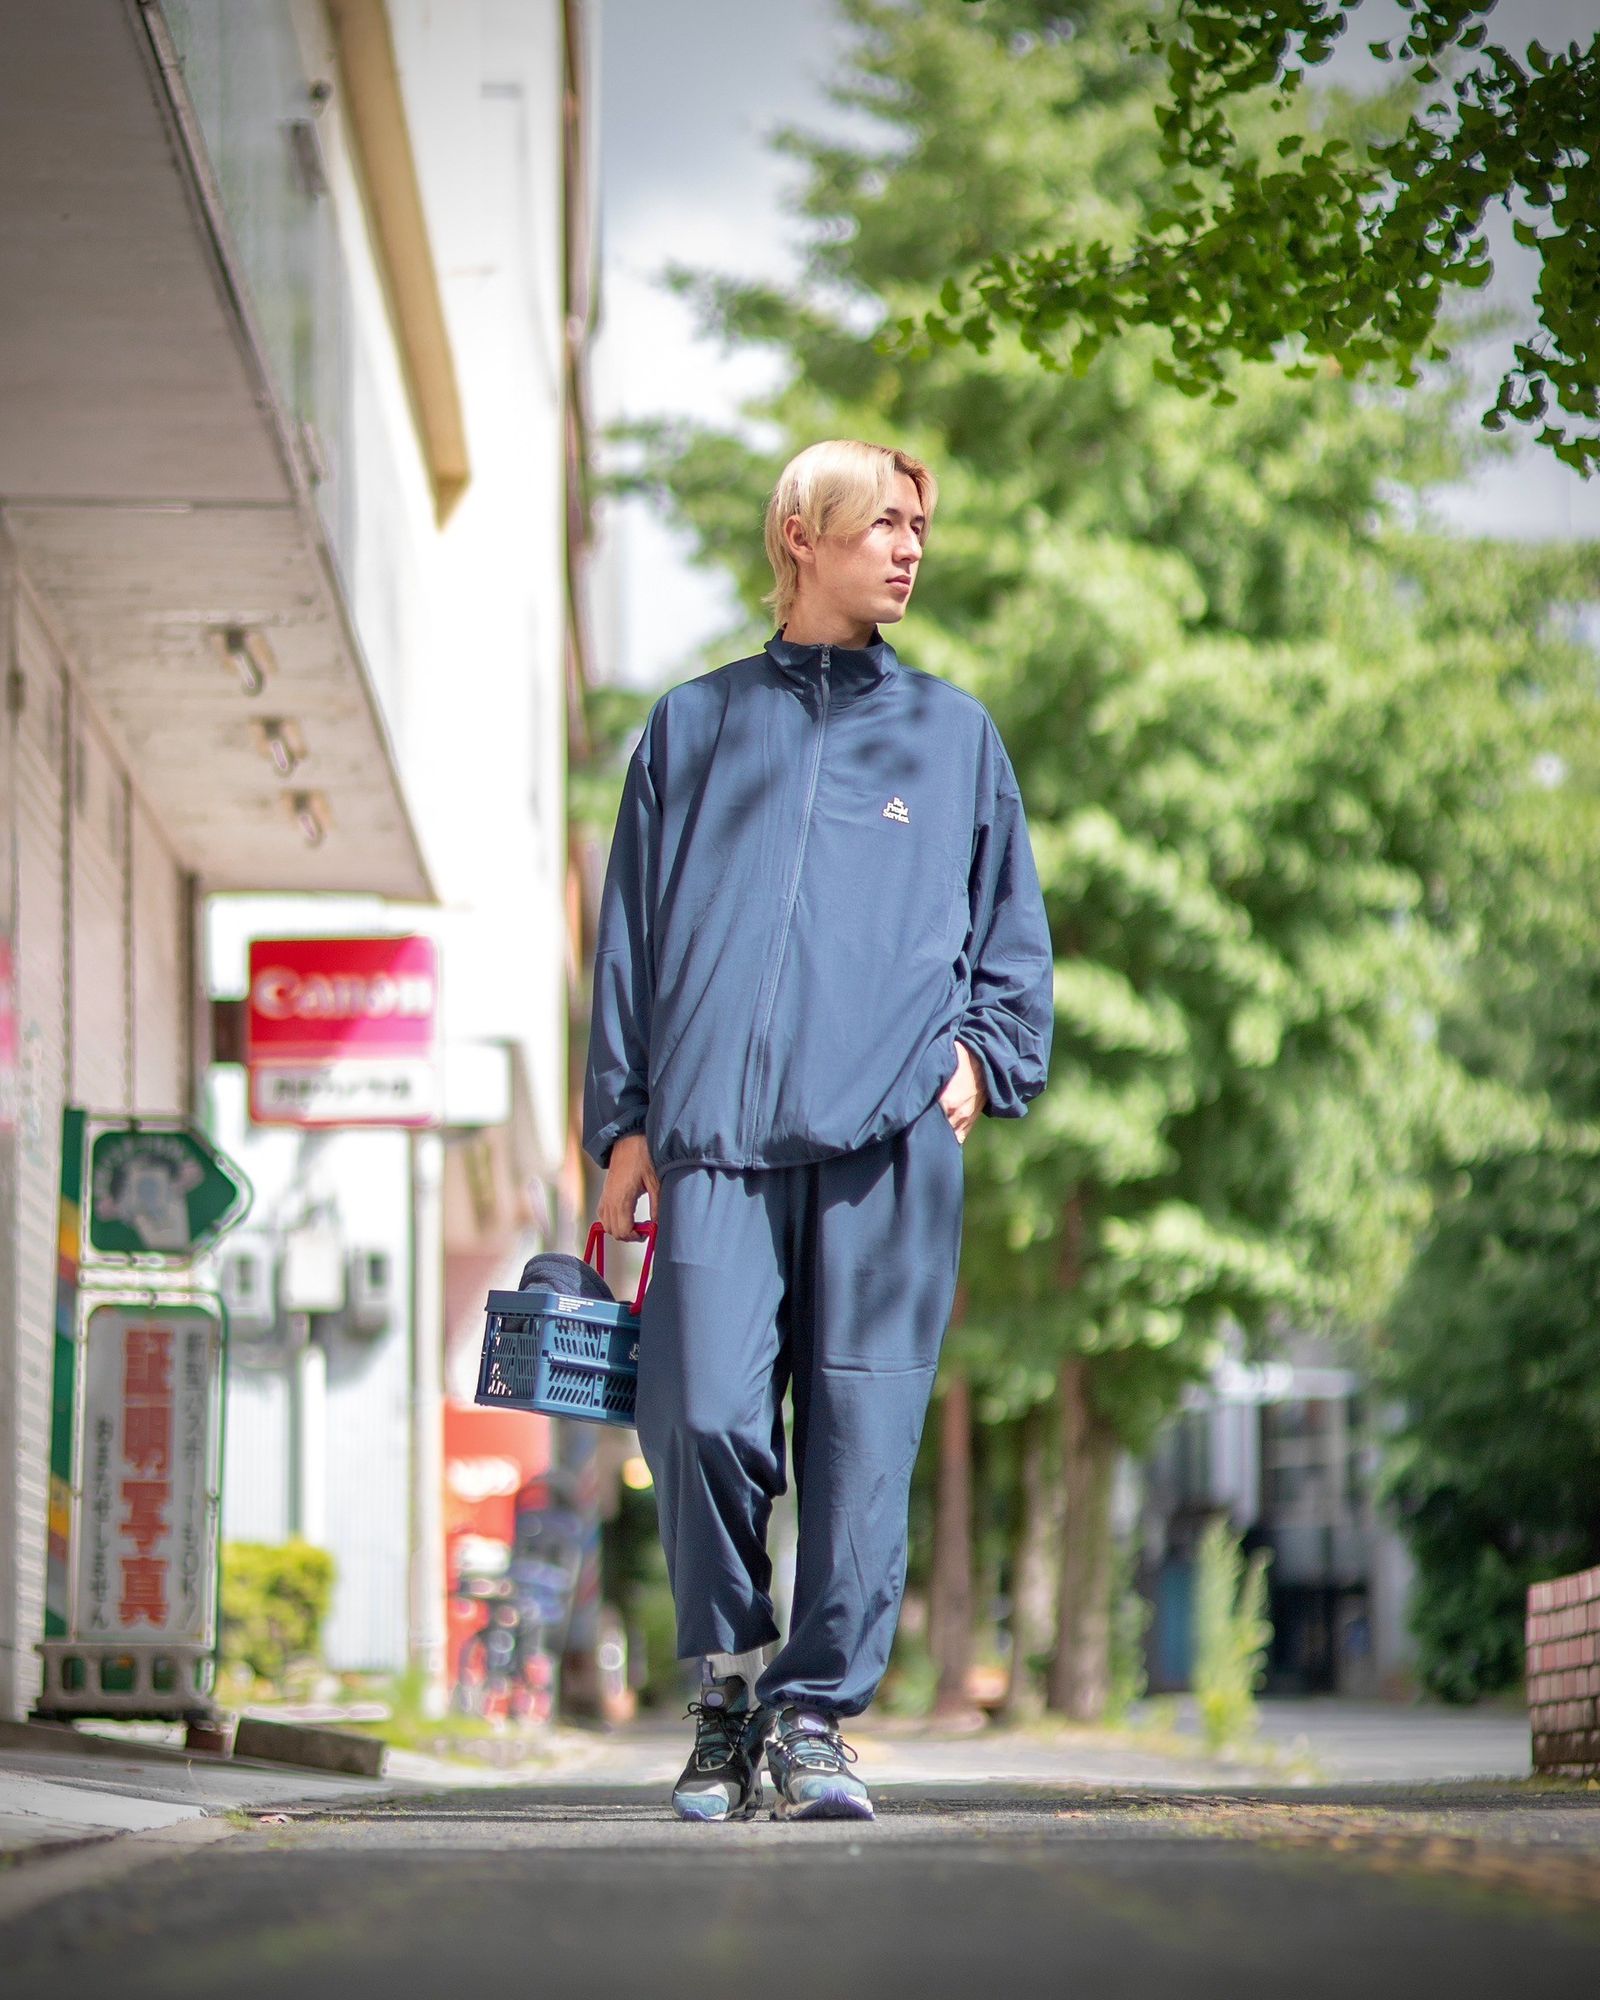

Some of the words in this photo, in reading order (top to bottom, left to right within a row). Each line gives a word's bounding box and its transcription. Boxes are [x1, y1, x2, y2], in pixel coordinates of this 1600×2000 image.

[253, 966, 433, 1021] Canon
[117, 1328, 175, 1630] 証明写真
